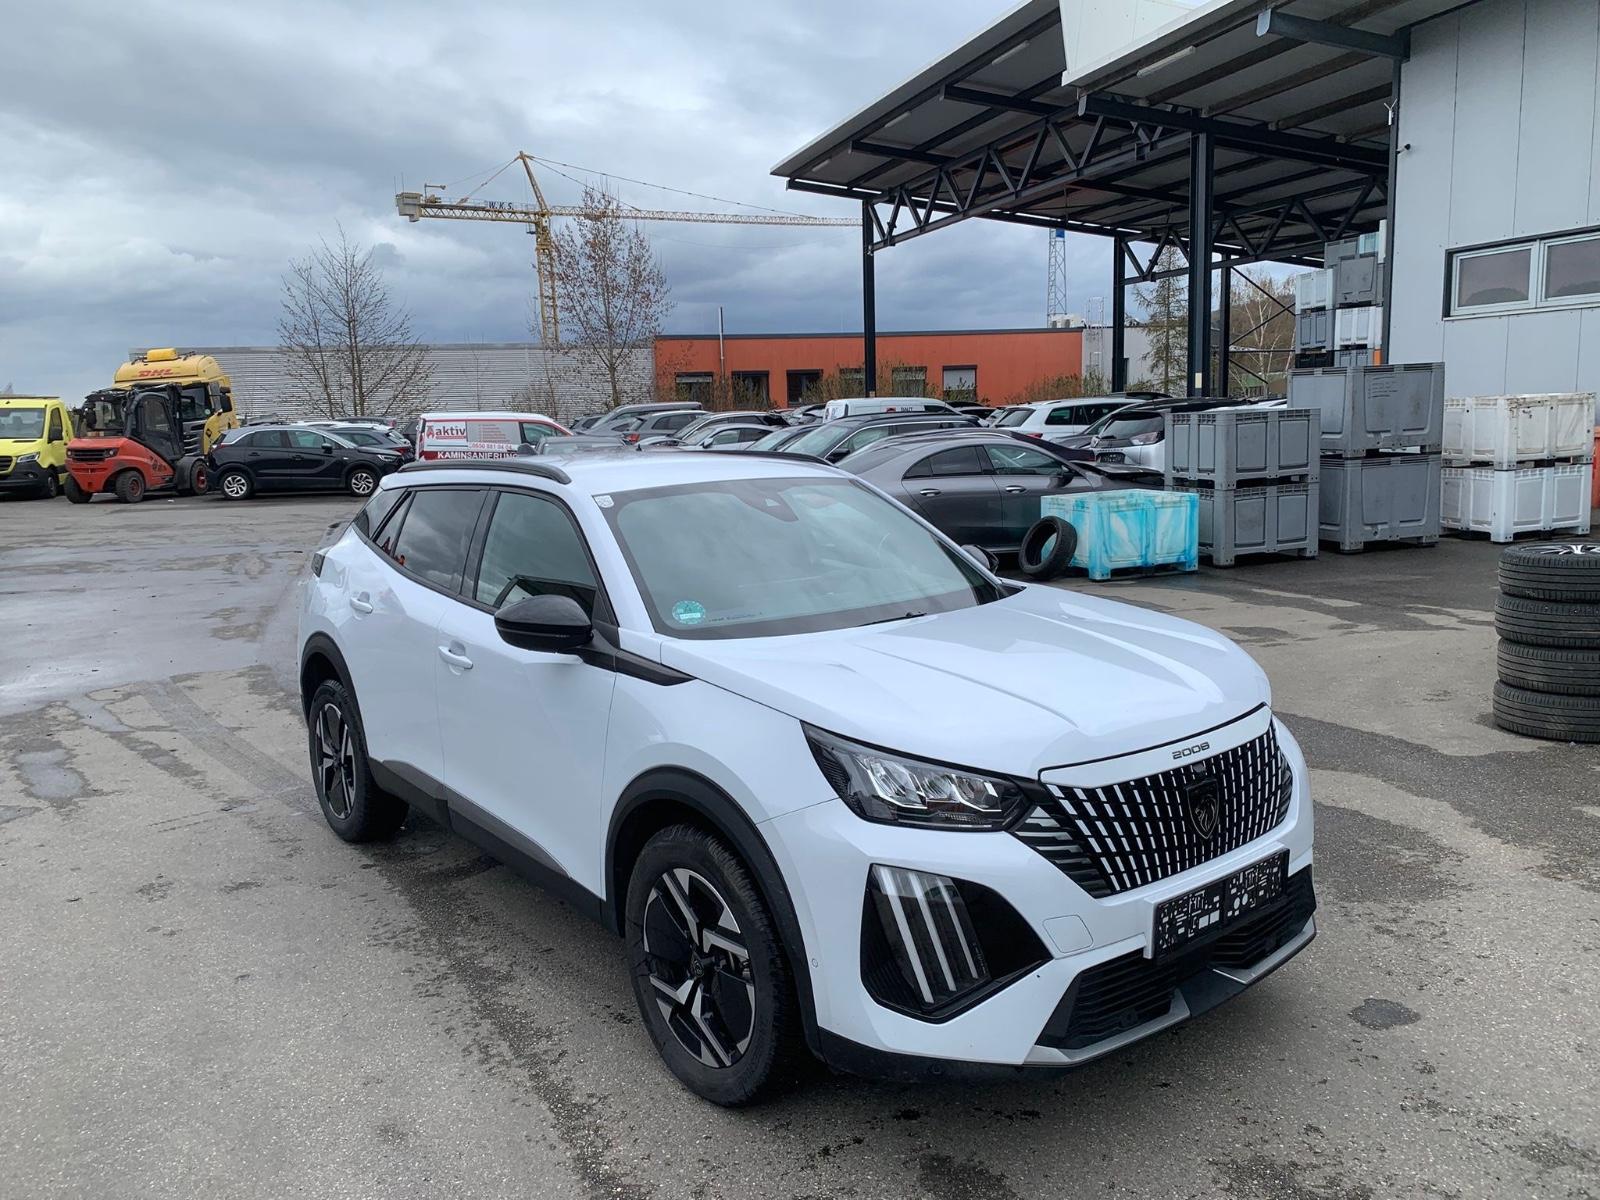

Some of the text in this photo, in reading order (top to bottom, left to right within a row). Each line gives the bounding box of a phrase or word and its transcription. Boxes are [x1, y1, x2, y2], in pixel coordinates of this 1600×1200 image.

[138, 368, 174, 377] DHL
[435, 425, 466, 436] aktiv
[1171, 741, 1210, 760] 2008
